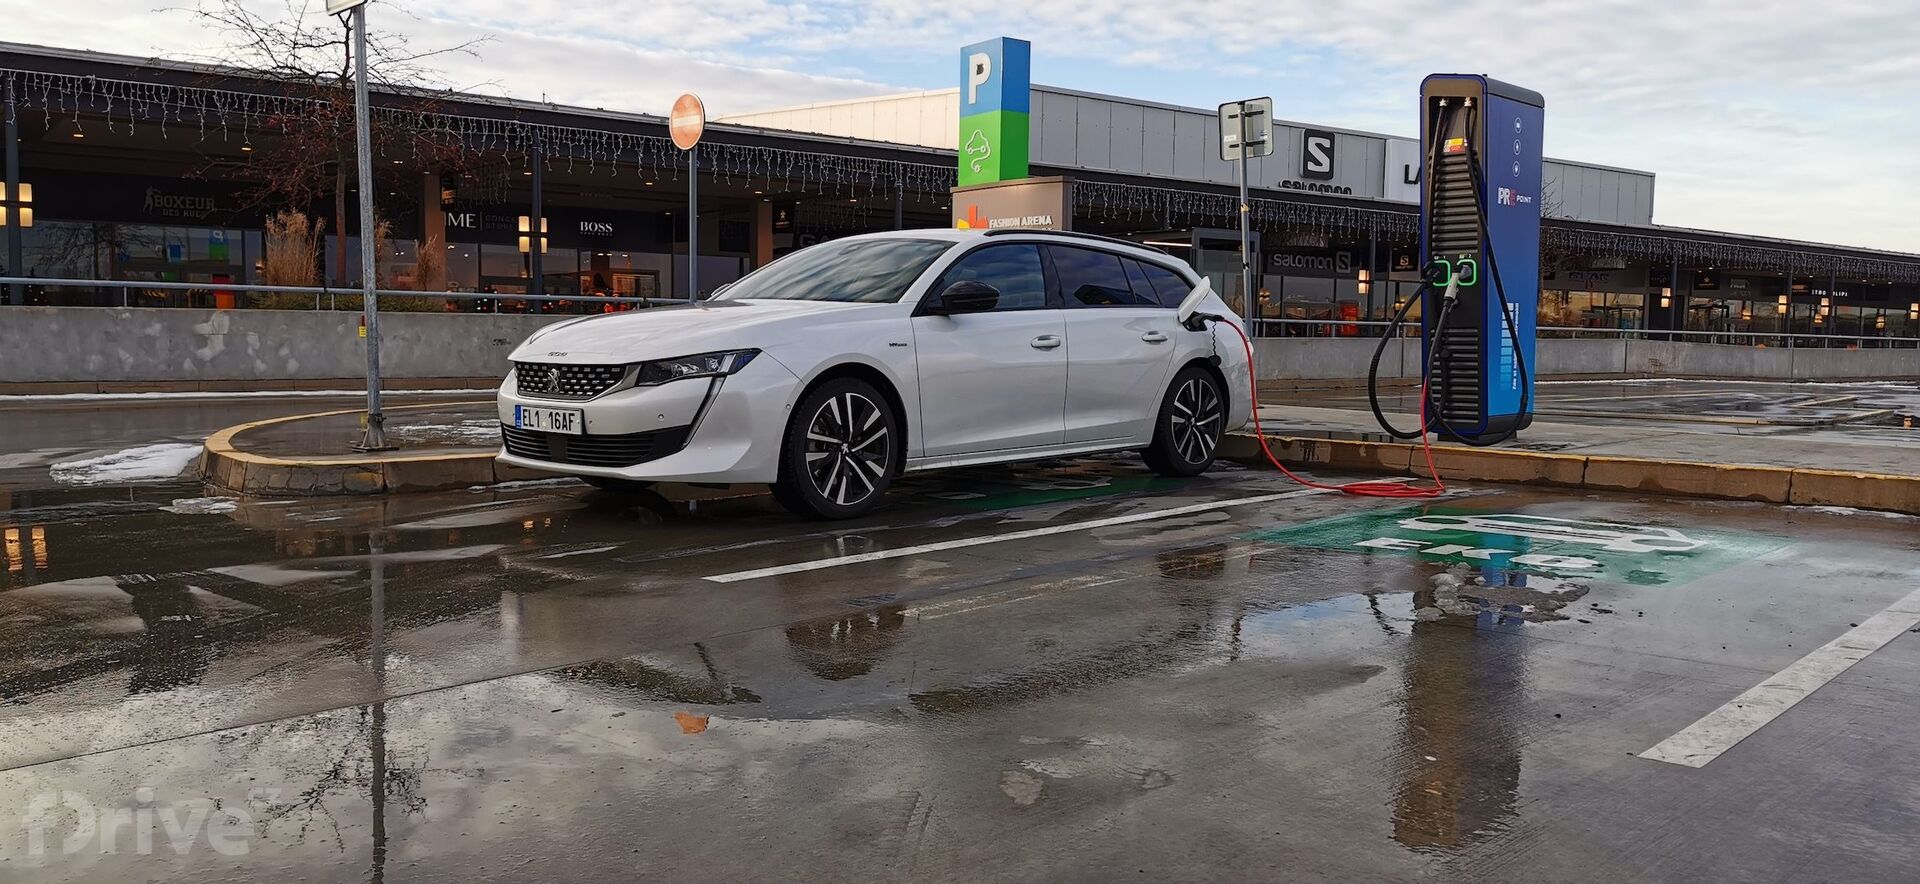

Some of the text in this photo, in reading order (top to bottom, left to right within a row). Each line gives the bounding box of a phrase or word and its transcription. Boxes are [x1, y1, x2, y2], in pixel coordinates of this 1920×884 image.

[968, 52, 992, 105] P
[154, 194, 216, 210] BOXEUR
[1497, 187, 1532, 207] PRE POINT
[163, 208, 179, 217] DES
[448, 212, 476, 229] ME
[485, 214, 516, 223] CONCE
[580, 221, 613, 233] BOSS
[989, 215, 1053, 229] FASHION ARENA
[1273, 253, 1334, 270] salomon
[522, 408, 575, 432] EL1 16AF
